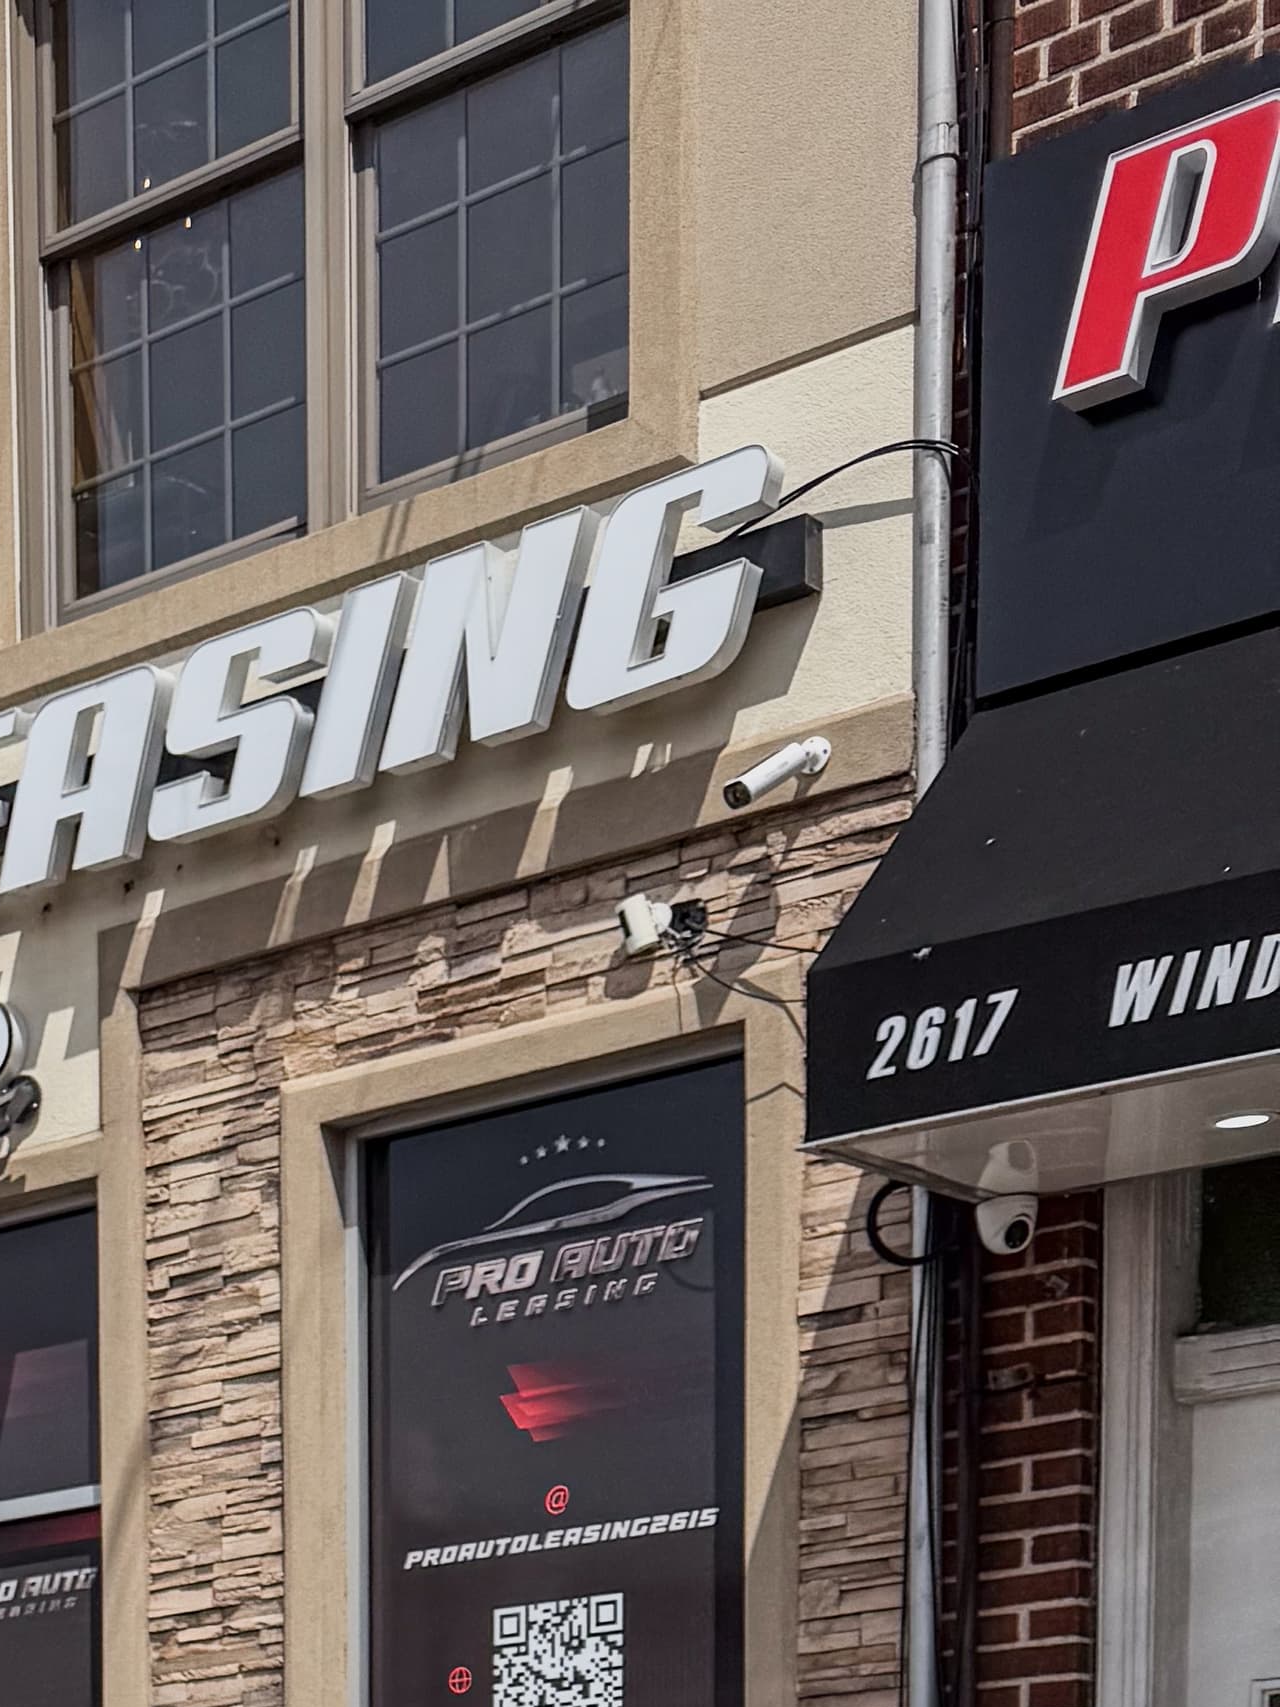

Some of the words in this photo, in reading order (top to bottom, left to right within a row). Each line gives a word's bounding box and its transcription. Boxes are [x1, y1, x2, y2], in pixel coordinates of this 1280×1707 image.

[1053, 88, 1280, 412] P
[866, 988, 1020, 1081] 2617
[431, 1251, 543, 1307] PRO
[550, 1218, 703, 1283] AUTO
[470, 1273, 659, 1328] LEASING
[403, 1507, 720, 1570] PROAUTOLEASING2615
[21, 1567, 98, 1599] AUTO
